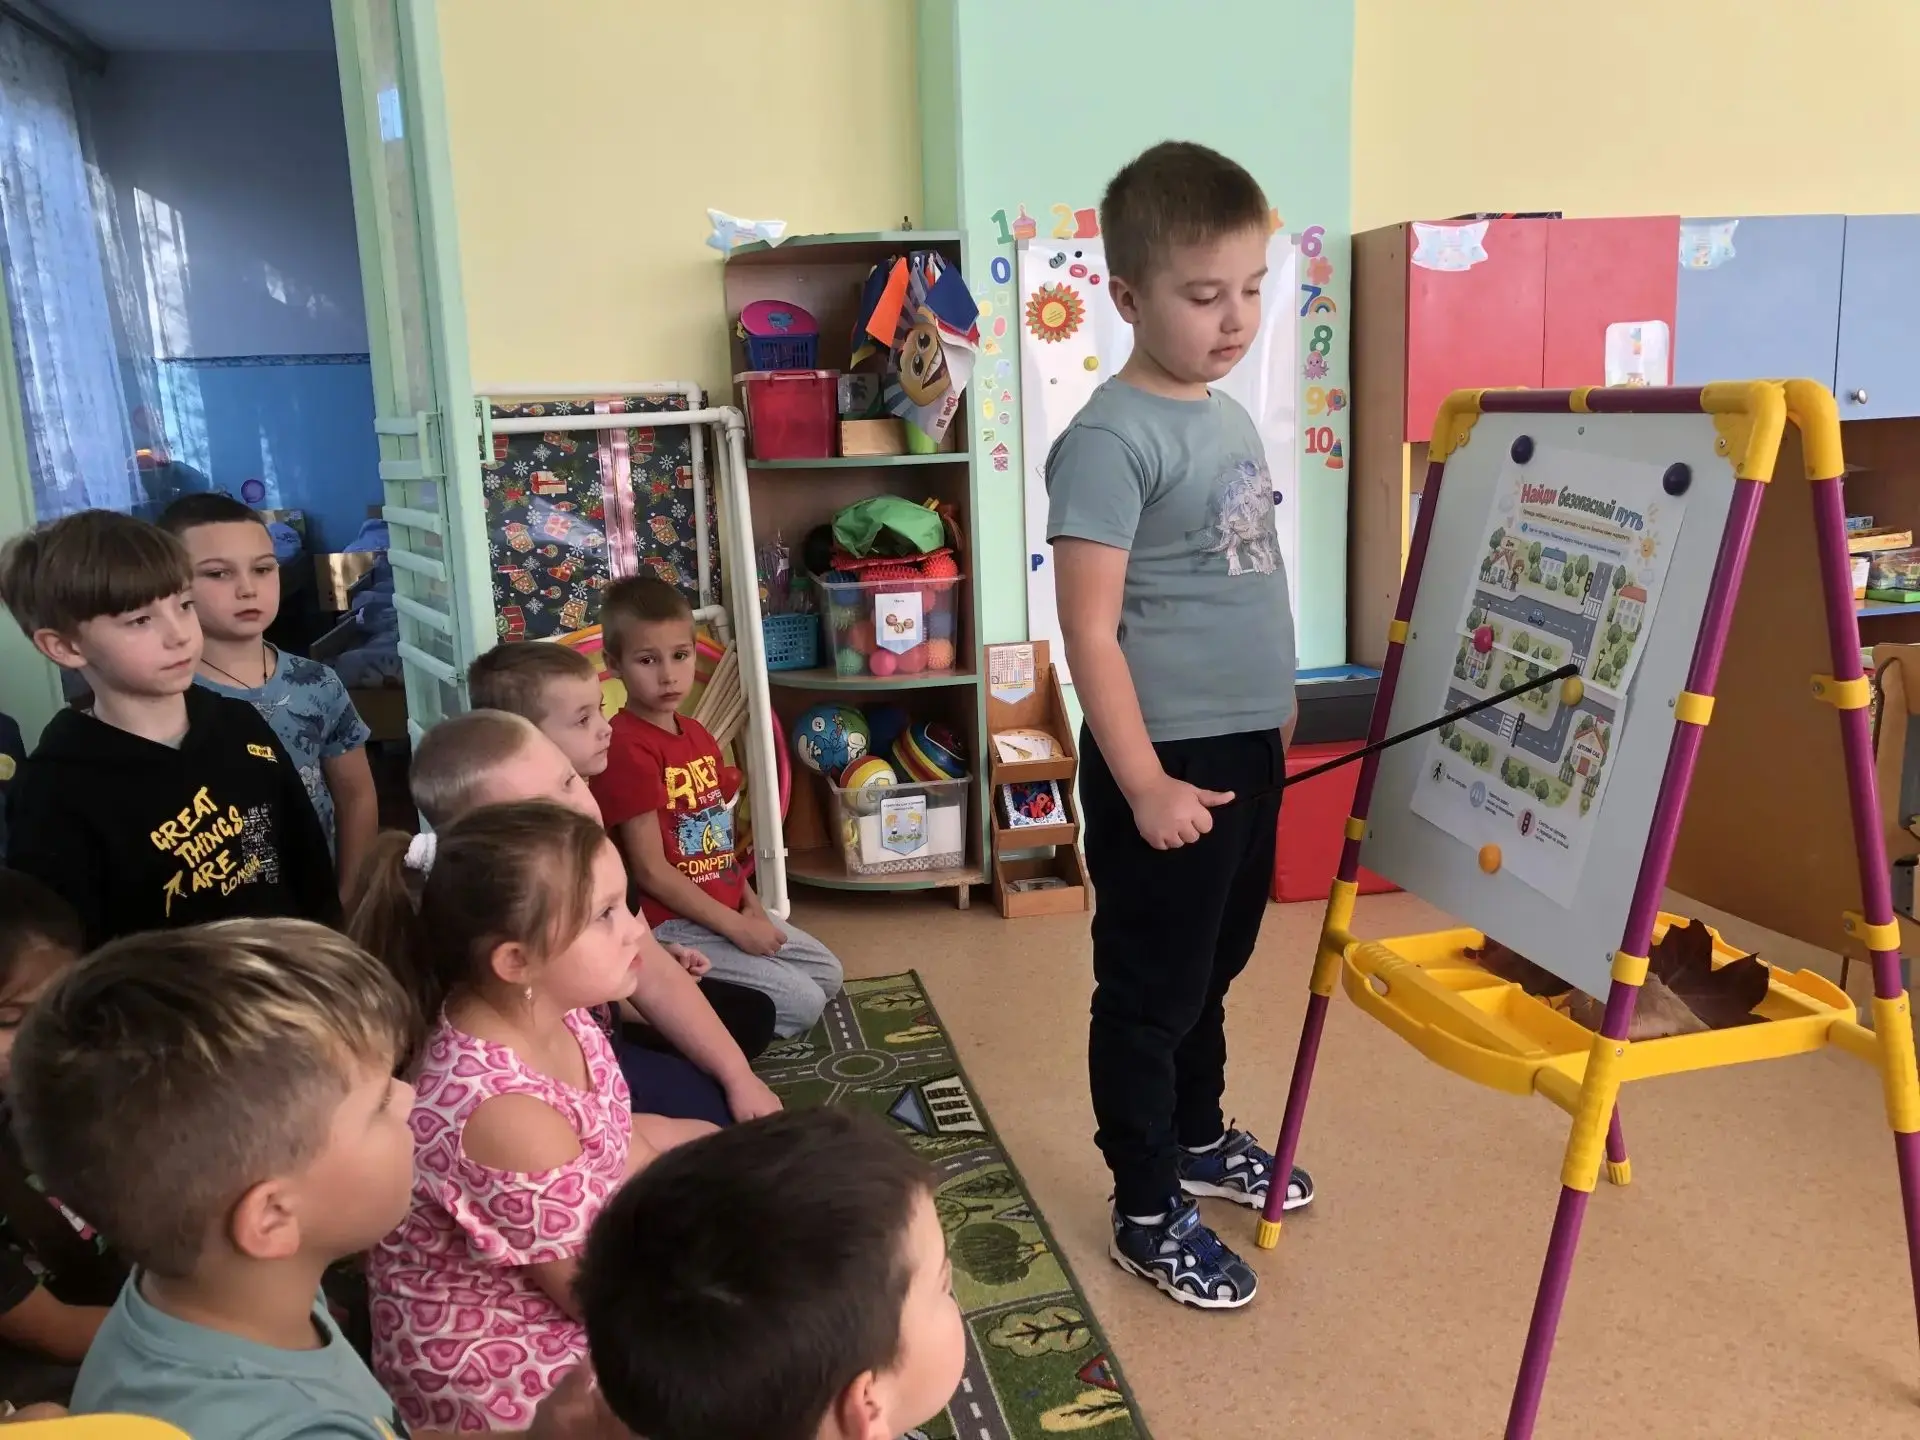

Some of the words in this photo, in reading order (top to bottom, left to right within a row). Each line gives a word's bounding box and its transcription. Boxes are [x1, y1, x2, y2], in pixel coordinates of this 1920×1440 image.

[991, 209, 1013, 245] 1
[1053, 205, 1073, 239] 2
[1301, 225, 1325, 257] 6
[1300, 284, 1322, 317] 7
[1309, 324, 1333, 356] 8
[1306, 386, 1326, 416] 9
[1304, 426, 1334, 454] 10
[1520, 483, 1557, 506] Найди
[1557, 485, 1617, 520] безопасный
[1614, 506, 1644, 531] путь
[150, 785, 218, 851] GREAT
[173, 805, 244, 868] THINGS
[192, 849, 237, 893] ARE
